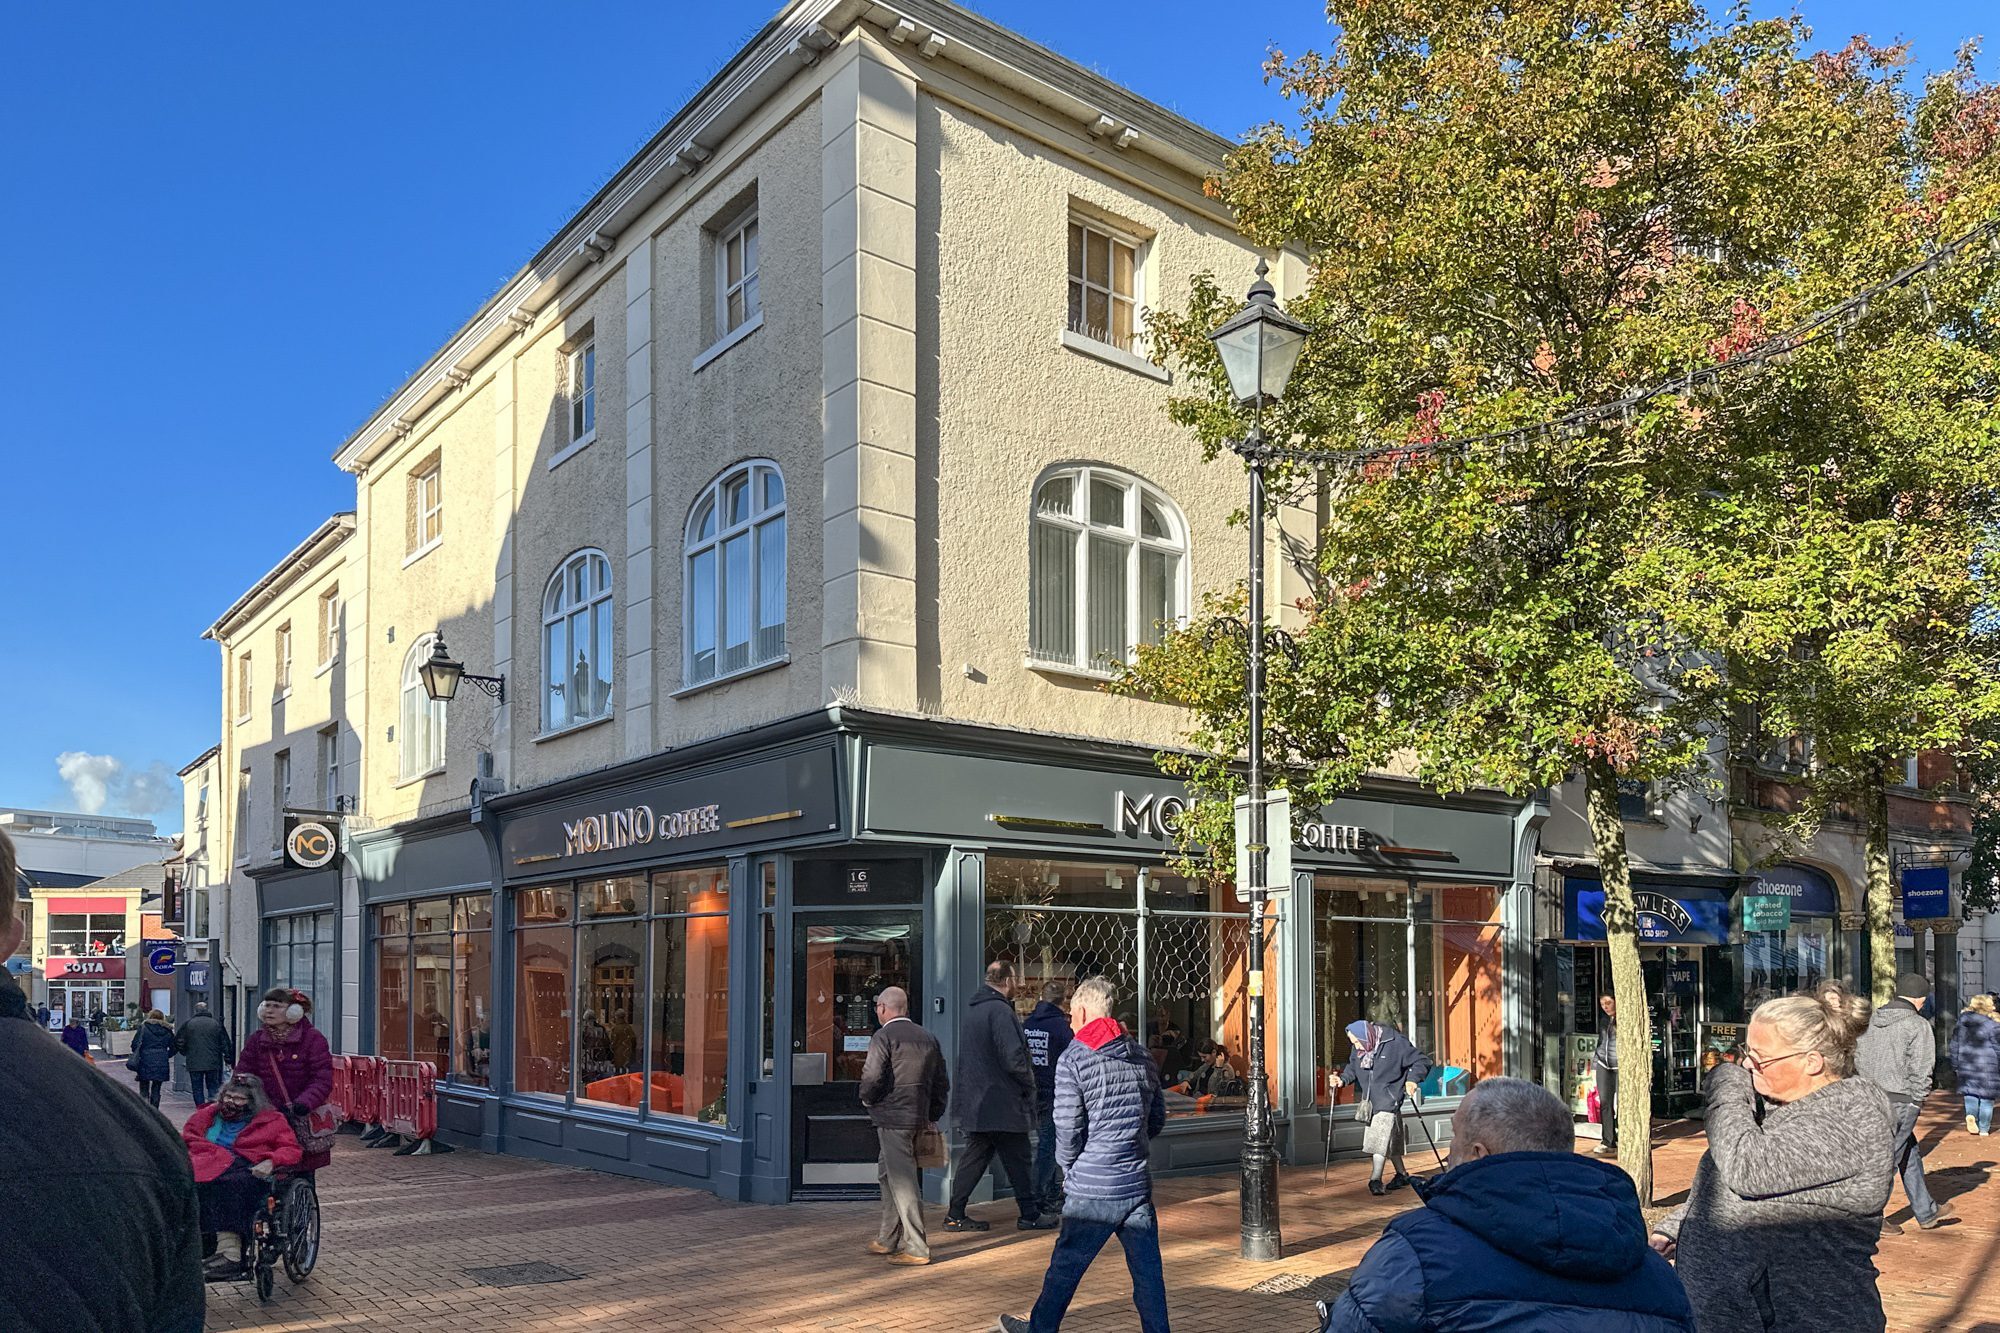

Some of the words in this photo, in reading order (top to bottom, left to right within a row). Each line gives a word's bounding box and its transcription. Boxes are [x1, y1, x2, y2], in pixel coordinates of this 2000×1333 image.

[563, 805, 654, 857] MOLINO
[658, 804, 720, 840] COFFEE
[851, 871, 867, 882] 16
[1757, 878, 1803, 897] shoezone
[1907, 888, 1944, 897] shoezone
[1754, 901, 1782, 909] Heated
[1637, 895, 1685, 927] WLESS
[1752, 910, 1784, 918] tobacco
[1655, 930, 1669, 938] SHOP
[63, 962, 104, 974] COSTA
[1672, 971, 1690, 982] VAPE
[1711, 1025, 1737, 1035] FREE
[1577, 1038, 1597, 1053] CB
